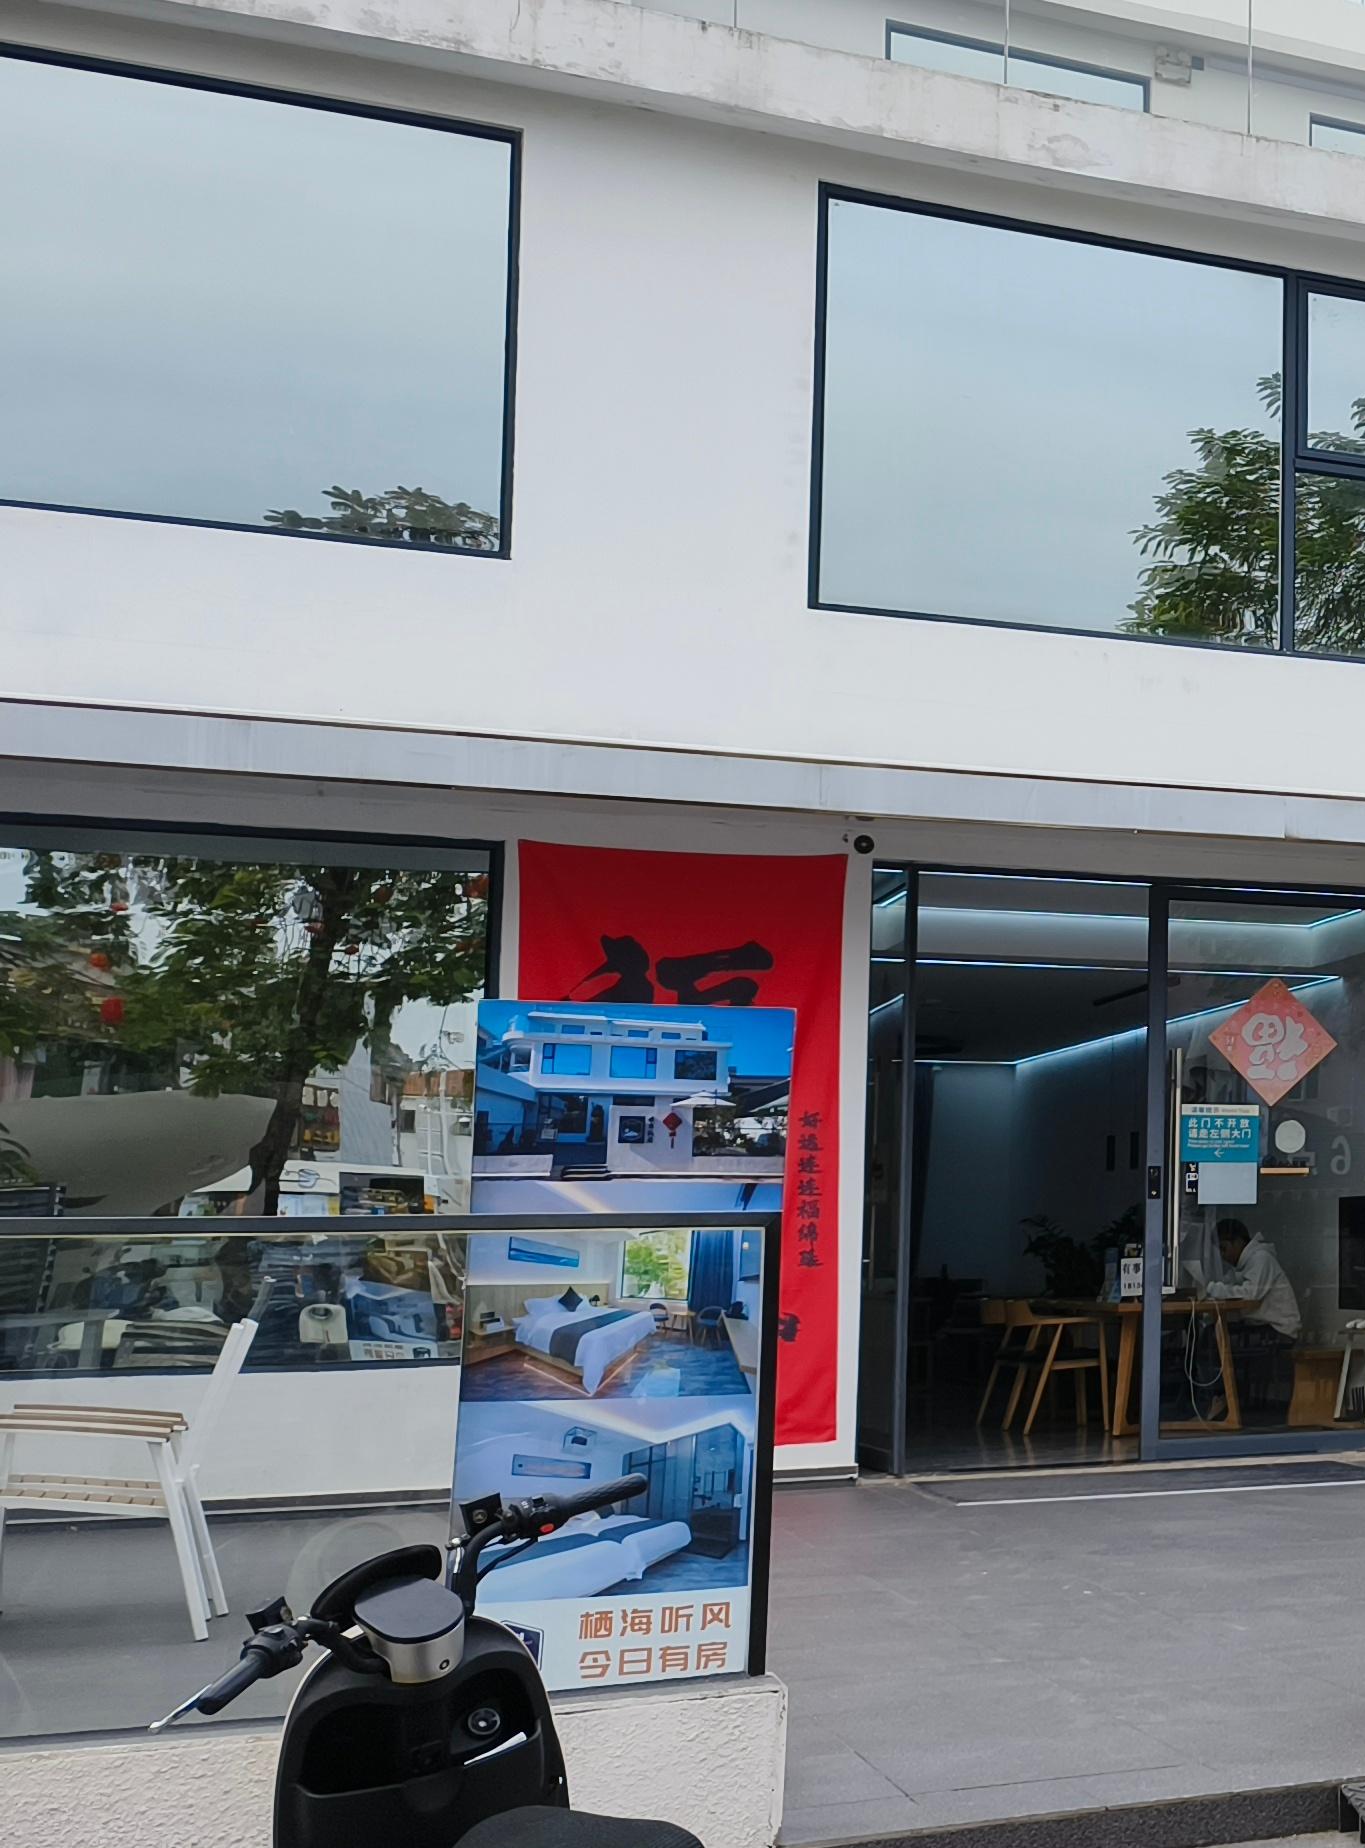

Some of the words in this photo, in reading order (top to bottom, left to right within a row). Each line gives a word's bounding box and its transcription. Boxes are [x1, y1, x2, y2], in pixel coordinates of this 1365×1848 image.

[1188, 1117, 1250, 1128] 此门不开放
[579, 1601, 732, 1641] 栖海听风
[579, 1641, 728, 1679] 今日有房
